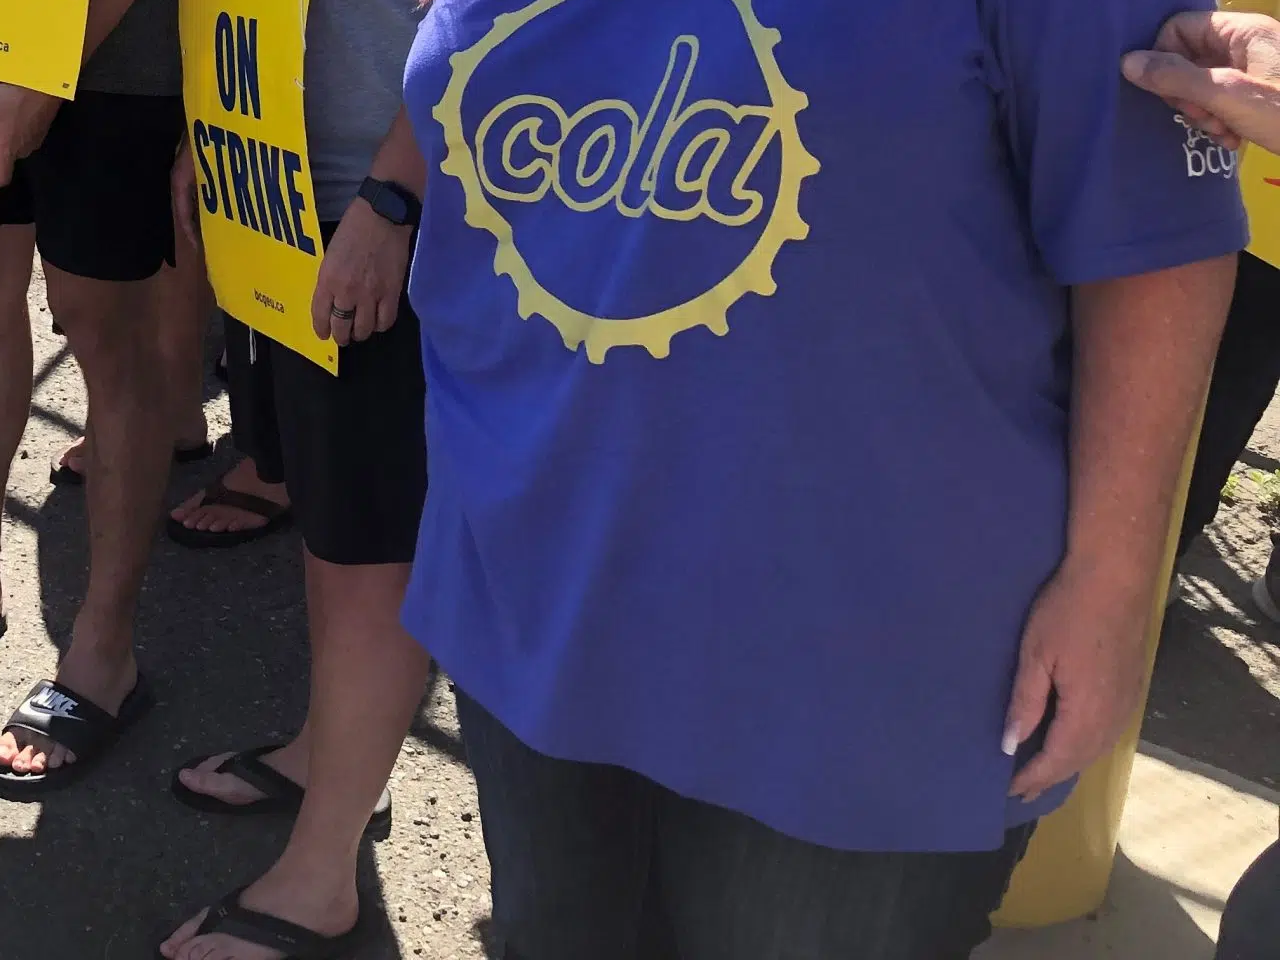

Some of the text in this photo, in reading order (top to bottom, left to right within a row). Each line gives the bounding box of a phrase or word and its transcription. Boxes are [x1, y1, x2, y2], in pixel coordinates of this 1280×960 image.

[215, 11, 261, 120] ON
[475, 34, 773, 227] cola
[1182, 143, 1238, 179] bcg
[194, 118, 316, 256] STRIKE
[254, 288, 285, 314] bcgeu.ca
